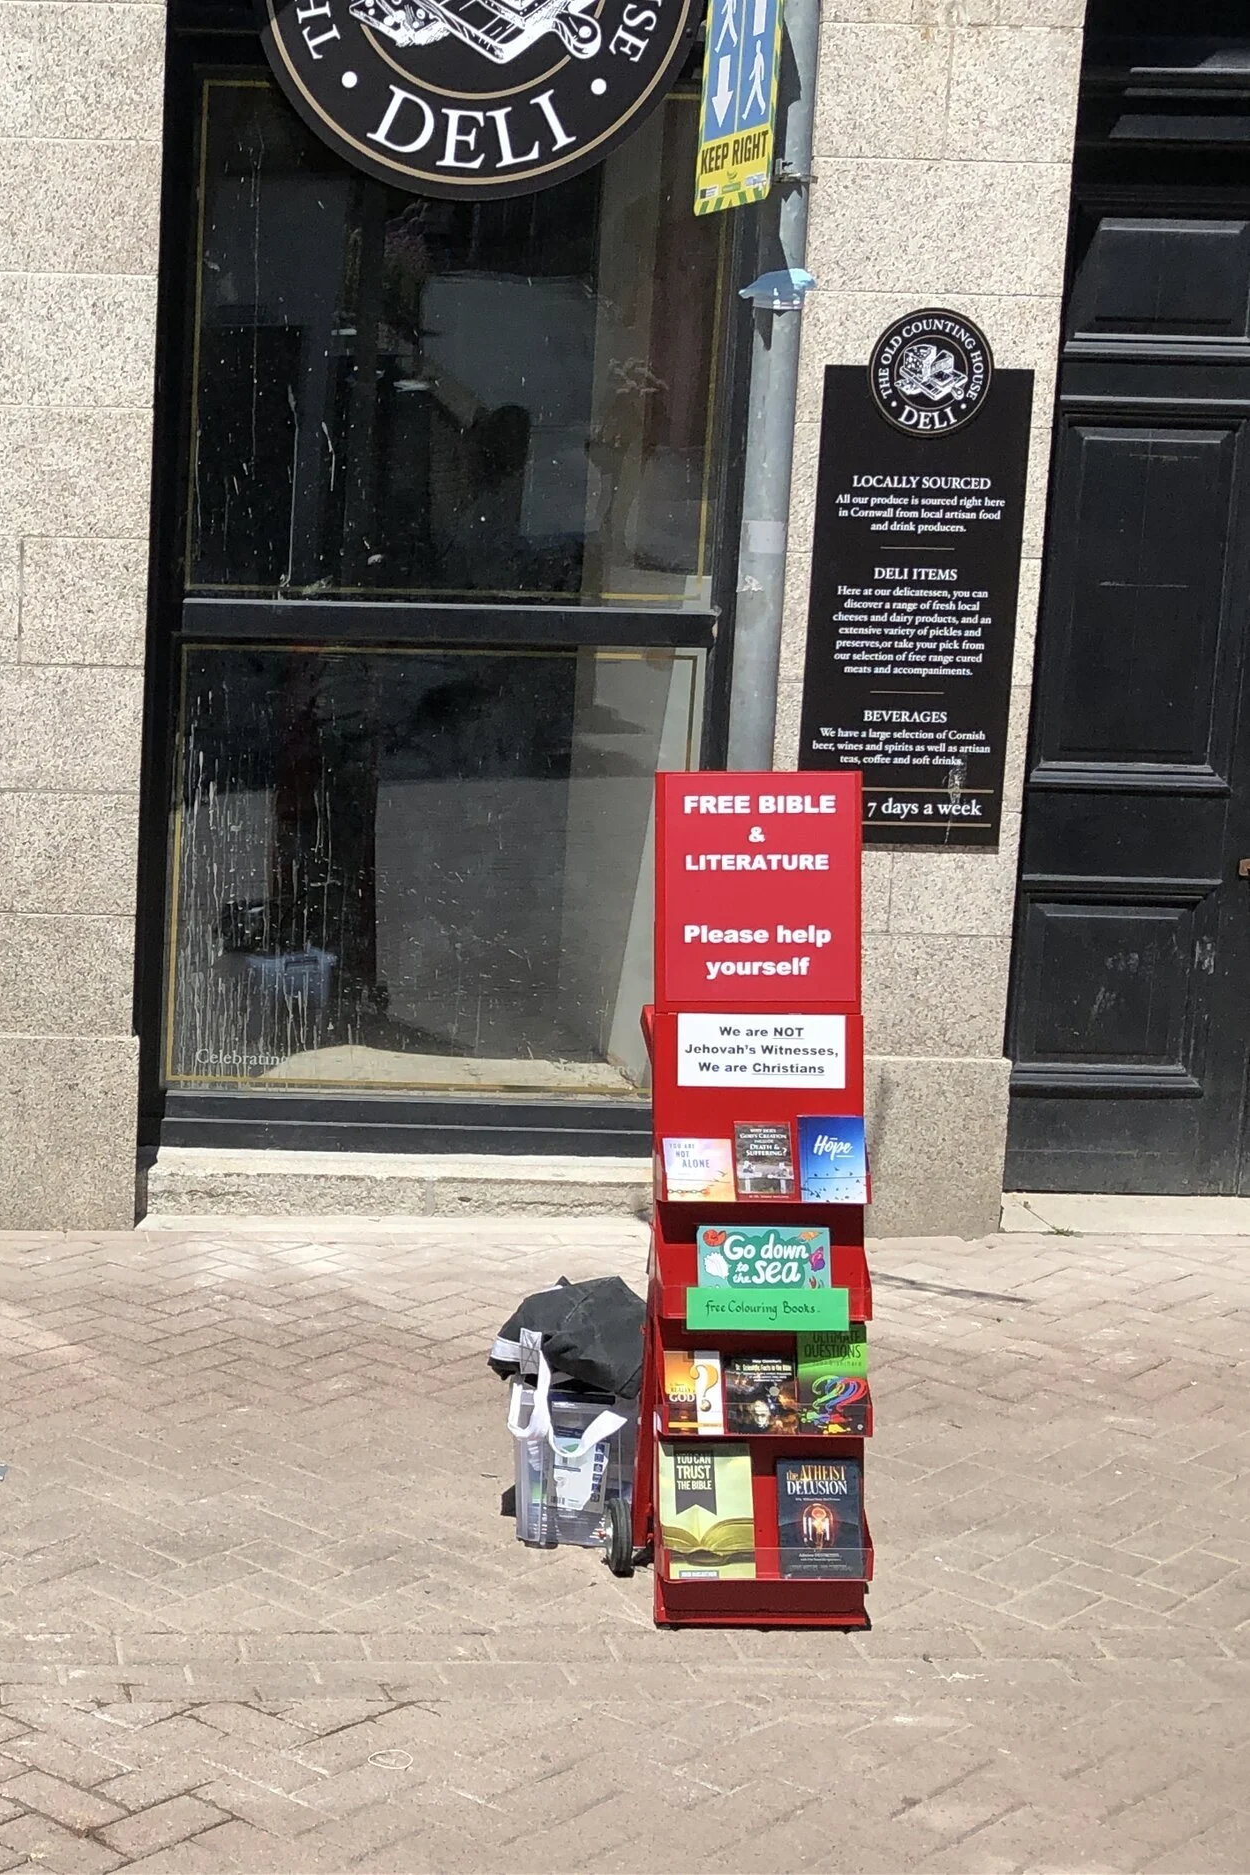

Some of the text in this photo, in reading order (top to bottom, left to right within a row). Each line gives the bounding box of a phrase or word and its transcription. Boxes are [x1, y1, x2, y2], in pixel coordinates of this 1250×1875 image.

[366, 85, 576, 169] DELI
[701, 130, 769, 175] KEEP RIGHT
[878, 319, 983, 400] THE OLD COUNTING HOUSE
[898, 405, 957, 429] DELI
[853, 475, 991, 489] LOCALLY SOURCED
[835, 495, 850, 504] All
[870, 495, 908, 506] produce
[911, 496, 919, 505] is
[921, 496, 957, 506] sourced
[959, 497, 981, 508] right
[984, 497, 1005, 506] here
[839, 508, 1000, 520] in Cornwall from local artisan food
[870, 521, 966, 534] and drink producers.
[874, 568, 958, 581] DELI ITEMS
[837, 586, 860, 595] Here
[863, 587, 872, 595] at
[893, 586, 950, 598] delicatessen,
[952, 591, 970, 599] you
[844, 599, 883, 609] discover
[893, 602, 917, 612] range
[920, 600, 931, 609] of
[932, 600, 956, 610] fresh
[958, 601, 980, 611] local
[833, 612, 867, 621] cheeses
[870, 612, 887, 622] and
[889, 613, 913, 624] dairy
[915, 613, 958, 625] products,
[961, 614, 978, 624] and
[839, 626, 981, 638] extensive variety of pickles and
[894, 639, 984, 651] take your pick from
[852, 651, 894, 661] selection
[896, 651, 907, 661] of
[908, 652, 926, 661] free
[929, 655, 953, 665] range
[956, 653, 982, 663] cured
[844, 664, 973, 677] meats and accompaniments.
[863, 710, 948, 723] BEVERAGES
[819, 727, 985, 740] We have a large selection of Cornish
[812, 740, 835, 751] beer,
[837, 741, 863, 750] wines
[865, 742, 882, 751] and
[885, 742, 913, 753] spirits
[927, 743, 945, 752] well
[959, 744, 990, 753] artisan
[840, 755, 861, 764] teas,
[863, 755, 891, 763] coffee
[893, 755, 910, 764] and
[912, 755, 929, 765] soft
[683, 795, 836, 814] FREE BIBLE
[868, 798, 982, 818] 7 days a week
[748, 827, 765, 842] &
[685, 854, 829, 871] LITERATURE
[684, 925, 831, 947] Please help
[706, 957, 810, 980] yourself
[719, 1026, 804, 1037] We are NOT
[685, 1044, 839, 1057] Jehovah's Witnesses,
[699, 1062, 825, 1074] We are Christians
[813, 1135, 852, 1160] Hope
[682, 1159, 710, 1168] ALONE
[723, 1234, 809, 1261] Go down
[736, 1262, 748, 1272] to
[752, 1261, 801, 1284] sea
[733, 1274, 751, 1283] the
[728, 1301, 777, 1320] Colouring
[805, 1344, 861, 1358] QUESTIONS
[669, 1393, 695, 1402] GOD
[677, 1465, 711, 1479] TRUST
[786, 1465, 846, 1481] the ATHEIST
[677, 1481, 712, 1490] THE BIBLE
[787, 1481, 847, 1495] DELUSION
